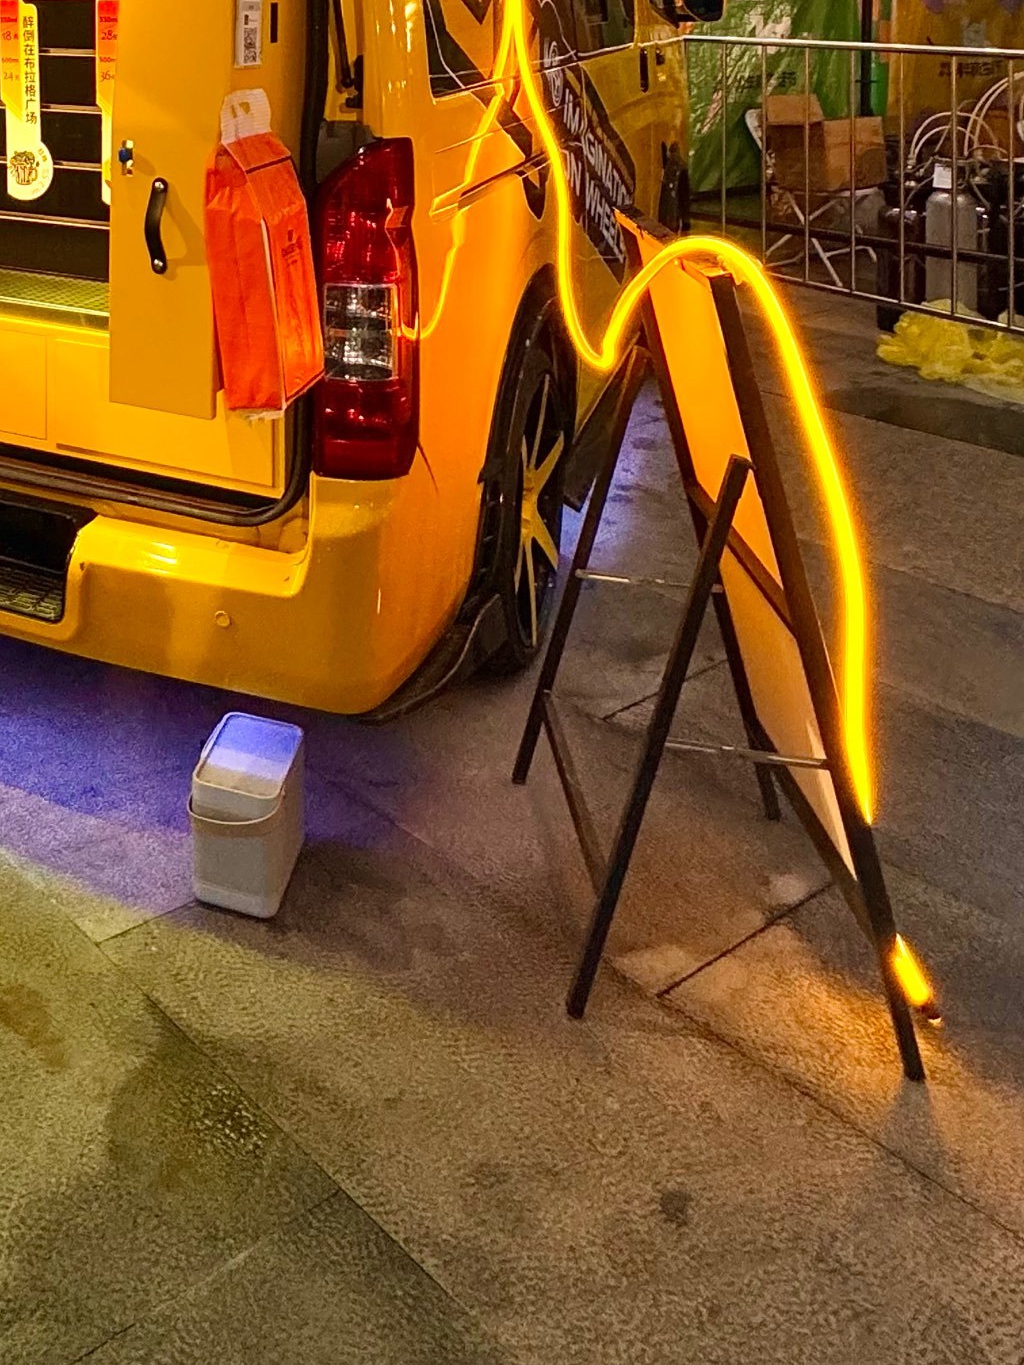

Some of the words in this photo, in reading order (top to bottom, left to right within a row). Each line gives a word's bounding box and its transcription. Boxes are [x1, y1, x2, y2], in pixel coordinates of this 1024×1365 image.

[22, 15, 37, 125] 醉倒在布拉格广场
